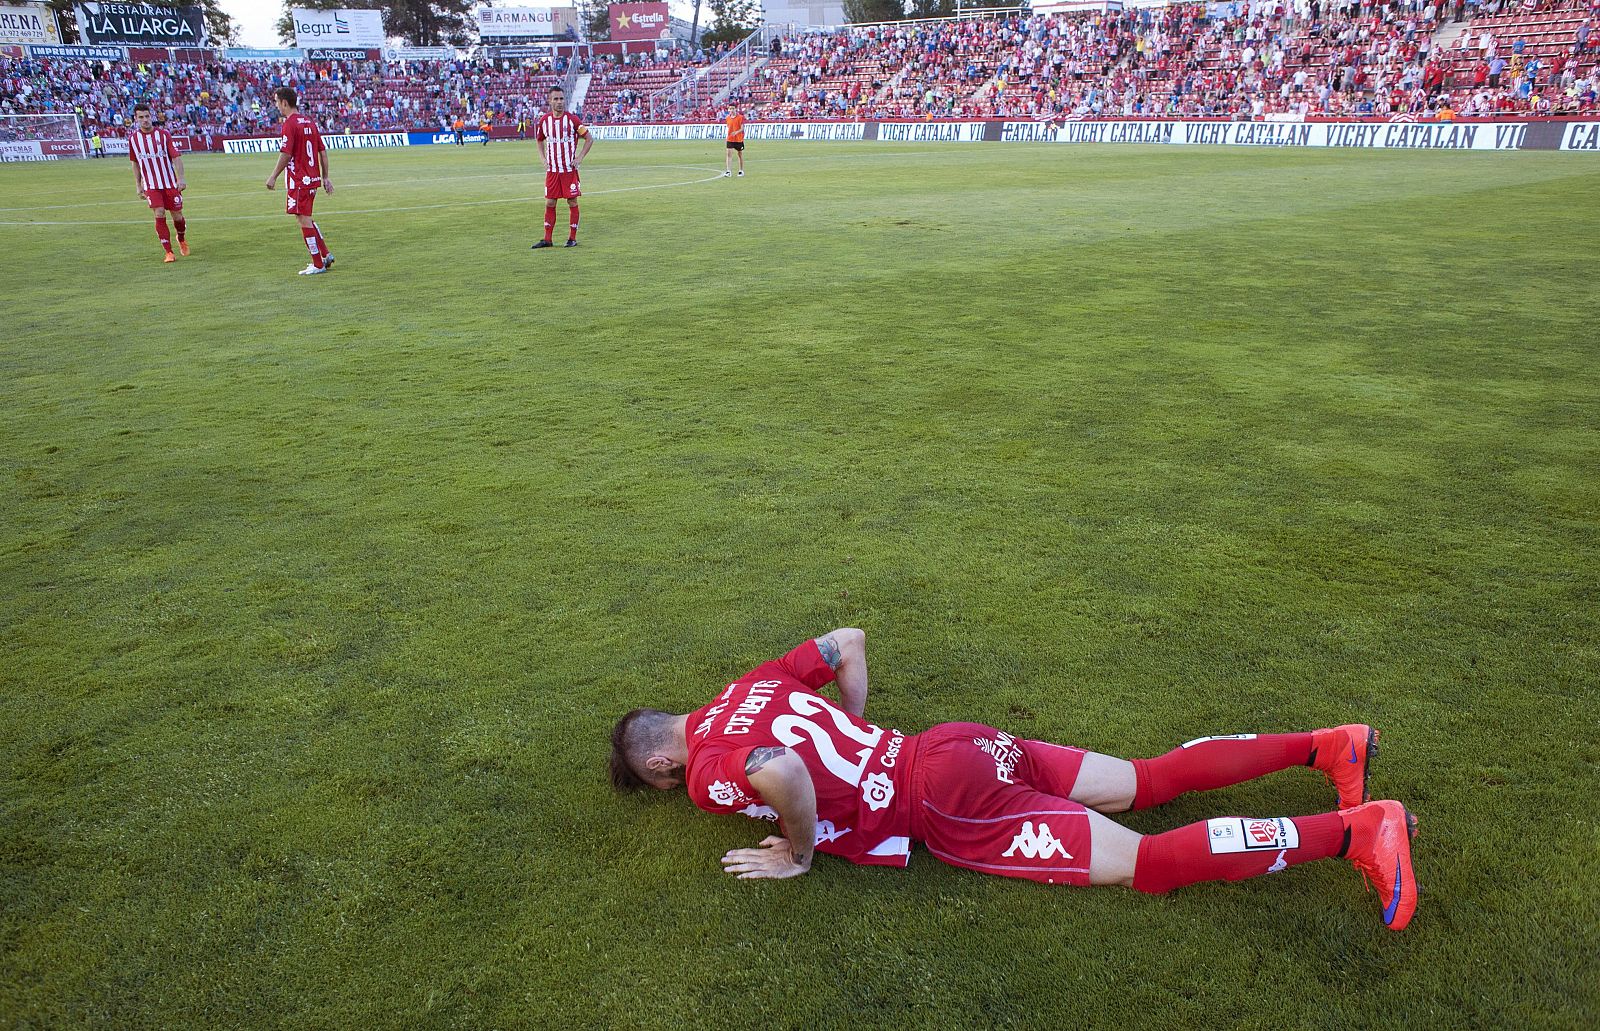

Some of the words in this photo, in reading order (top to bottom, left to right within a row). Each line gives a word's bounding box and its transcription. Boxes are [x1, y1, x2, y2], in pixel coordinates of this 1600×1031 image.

[0, 14, 42, 30] RENA
[632, 12, 664, 23] Estrella
[91, 16, 118, 34] LA
[121, 17, 194, 36] LLARGA
[33, 47, 86, 55] IMPREMTA
[325, 50, 366, 60] Kappa
[432, 134, 455, 144] LIGA
[603, 126, 628, 139] CATALAN
[632, 126, 651, 139] VICHY
[651, 126, 680, 139] CATALAN
[684, 125, 704, 139] VICHY
[808, 124, 836, 140] VICHY
[882, 123, 914, 140] VICHY
[914, 124, 962, 141] CATALAN
[1005, 123, 1058, 142] CATALAN
[1069, 123, 1107, 143] VICHY
[1110, 123, 1175, 143] CATALAN
[1185, 123, 1233, 144] VICHY
[1235, 123, 1313, 146] CATALAN
[1326, 124, 1381, 147] VICHY
[1384, 124, 1479, 149] CATALAN
[228, 140, 262, 153] VICHY
[324, 136, 355, 149] VICHY
[359, 134, 405, 147] CATALAN
[306, 140, 315, 167] 9
[771, 691, 885, 789] 22
[880, 737, 905, 768] Costa
